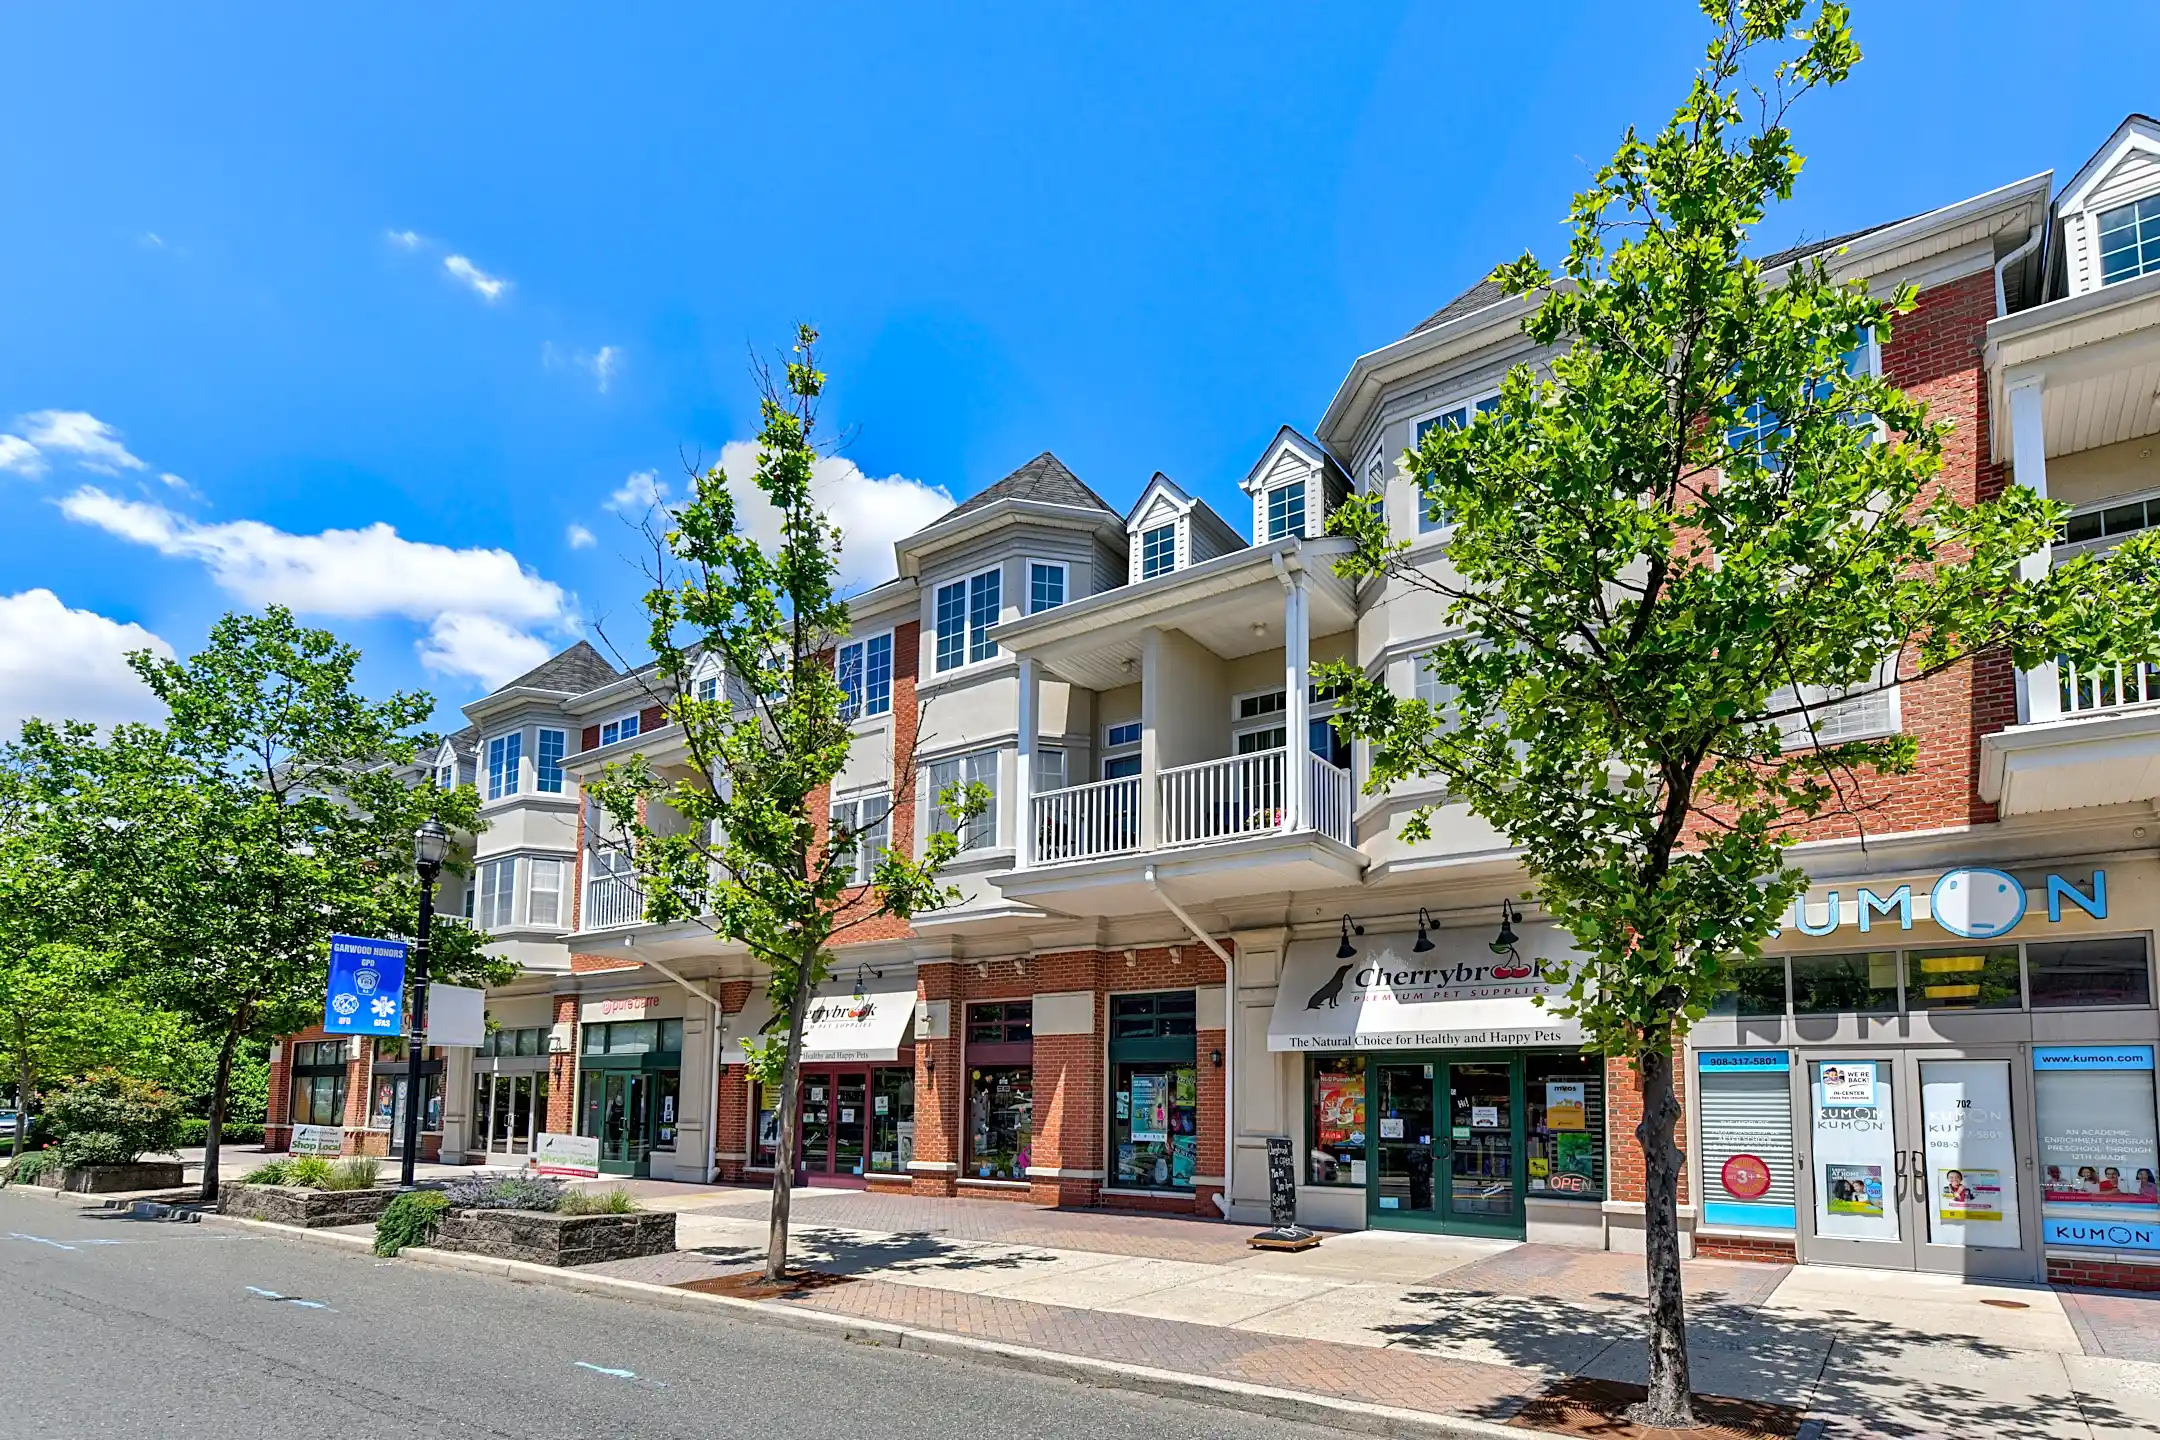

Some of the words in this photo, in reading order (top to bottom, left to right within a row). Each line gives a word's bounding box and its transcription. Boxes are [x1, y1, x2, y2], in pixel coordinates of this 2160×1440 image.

[1768, 867, 2107, 939] UMON
[333, 943, 372, 955] GARWOOD
[373, 947, 404, 959] HONORS
[1355, 958, 1551, 988] Cherrybrook
[1353, 991, 1424, 1002] PREMIUM
[1433, 989, 1460, 999] PET
[1470, 986, 1551, 997] SUPPLIES
[804, 1003, 878, 1022] errybrook
[373, 1019, 391, 1027] GFAS
[1290, 1037, 1309, 1047] The
[1312, 1036, 1351, 1047] Natural
[1354, 1035, 1392, 1046] Choice
[1395, 1034, 1412, 1045] for
[1415, 1033, 1461, 1046] Healthy
[1464, 1032, 1486, 1043] and
[1490, 1031, 1530, 1045] Happy
[1534, 1030, 1561, 1042] Pets
[837, 1052, 855, 1061] Happy
[1710, 1057, 1777, 1065] 908-317-5801
[2041, 1054, 2143, 1062] www.kumon.com
[1956, 1099, 1972, 1108] 702
[1817, 1107, 1882, 1120] KUMON
[291, 1140, 317, 1151] Shop
[319, 1142, 341, 1151] Local
[2047, 1144, 2101, 1152] PRESCHOOL
[1551, 1176, 1592, 1191] OPEN
[2056, 1226, 2150, 1244] KUMON
